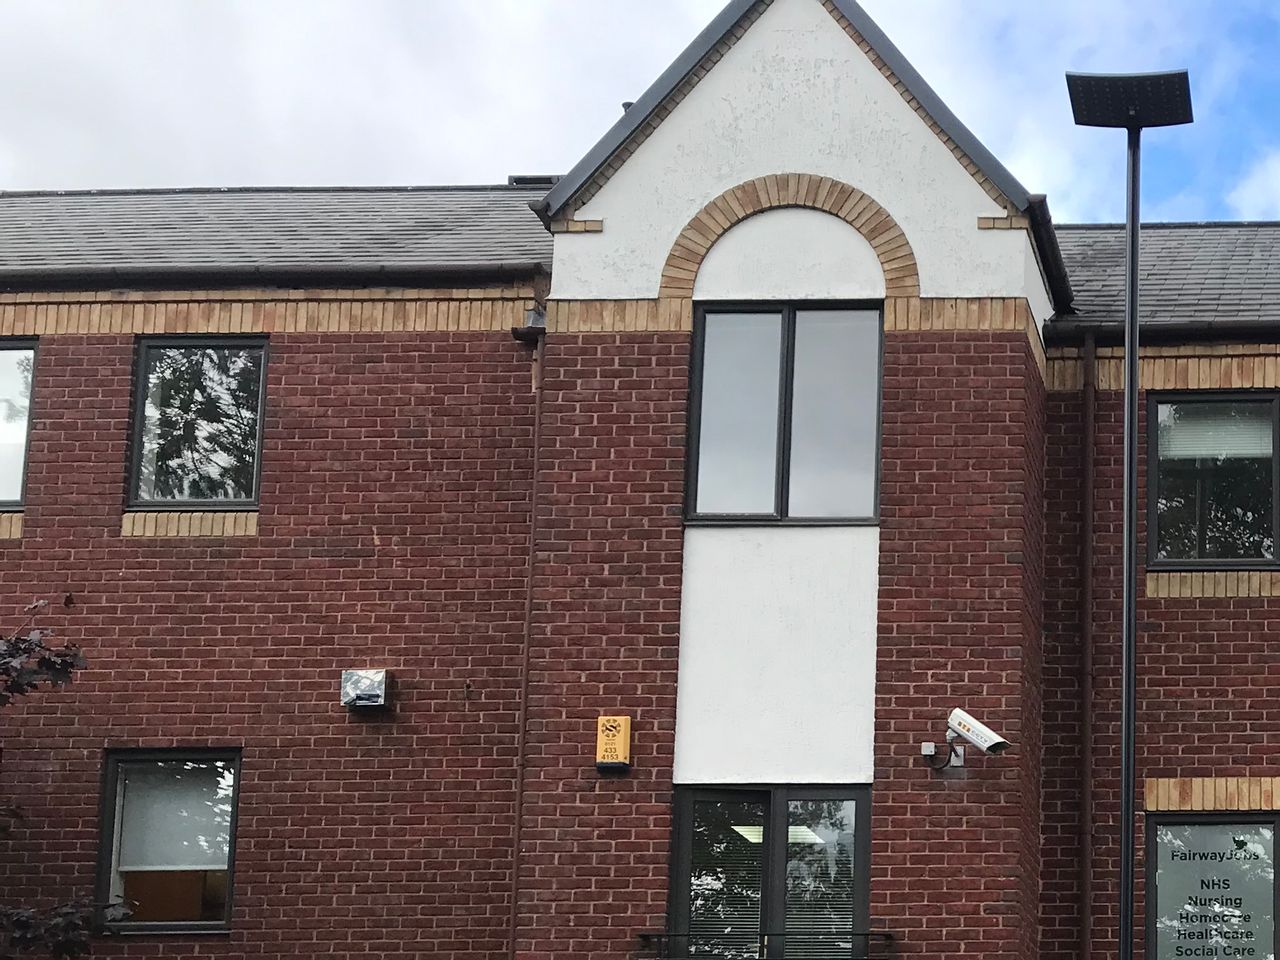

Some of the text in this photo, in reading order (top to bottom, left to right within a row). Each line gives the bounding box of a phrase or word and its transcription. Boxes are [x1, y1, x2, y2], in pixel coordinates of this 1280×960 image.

[1201, 879, 1230, 889] NHS
[1188, 896, 1242, 907] Nursing
[1175, 946, 1255, 956] Social Care
